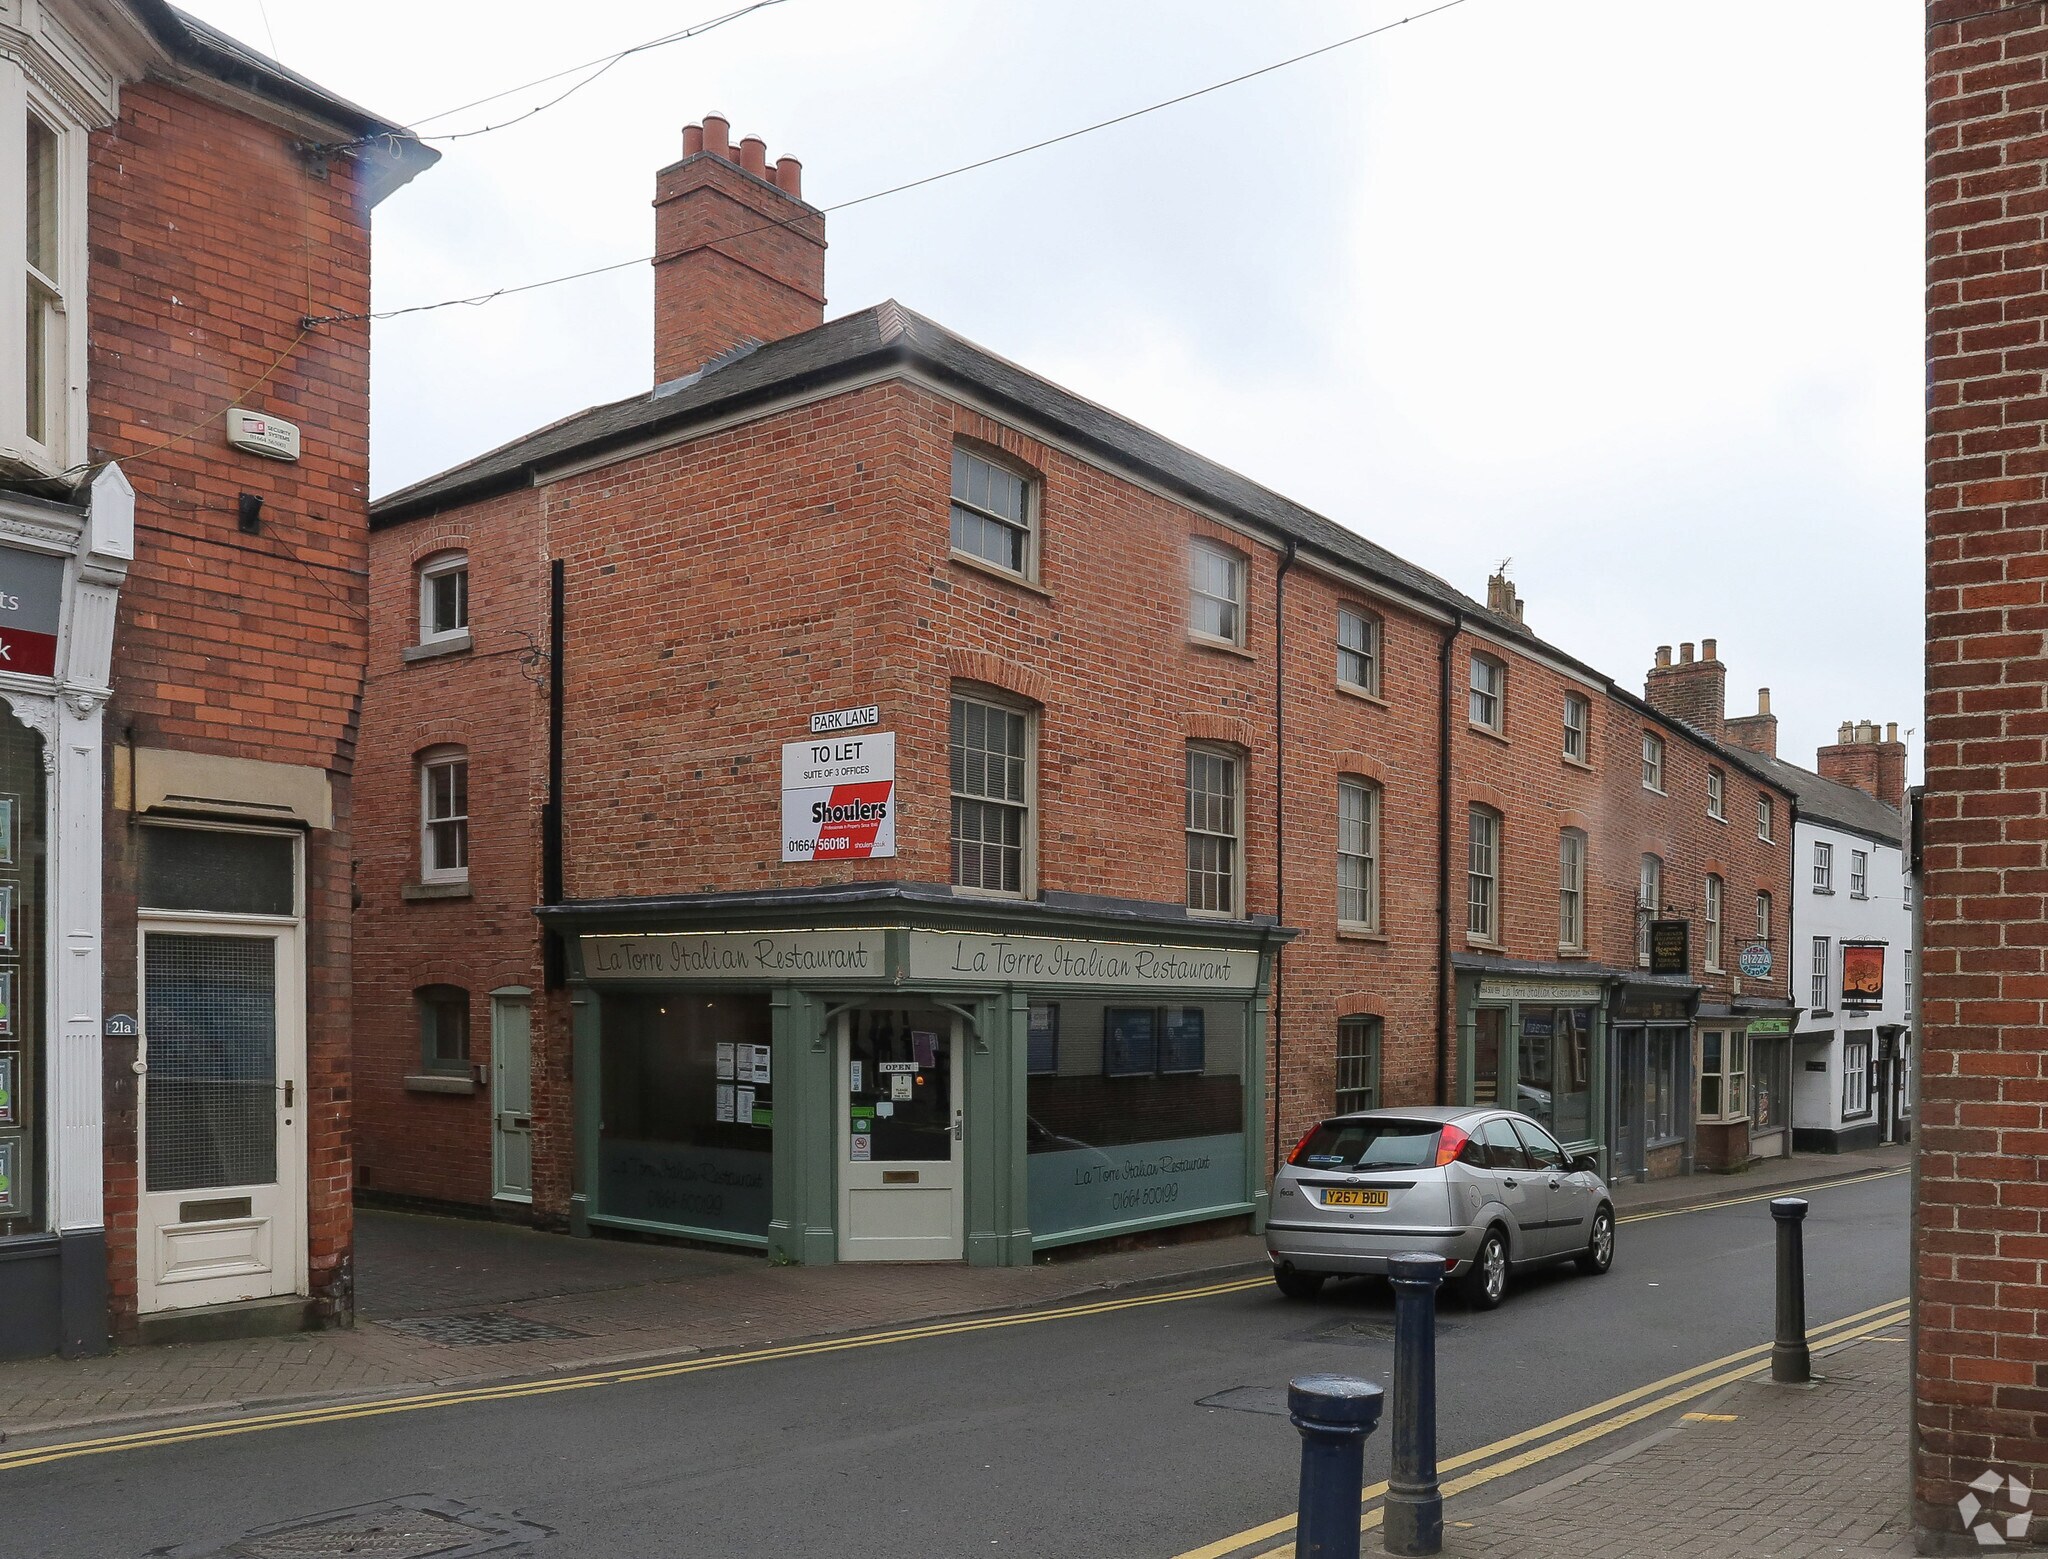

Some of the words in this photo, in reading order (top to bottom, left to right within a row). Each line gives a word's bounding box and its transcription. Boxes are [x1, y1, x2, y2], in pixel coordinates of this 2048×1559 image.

[814, 712, 842, 730] PARK
[846, 708, 875, 726] LANE
[811, 746, 830, 764] TO
[836, 742, 863, 761] LET
[804, 770, 822, 780] SUITE
[824, 768, 834, 778] OF
[836, 768, 840, 776] 3
[841, 765, 870, 776] OFFICES
[812, 798, 887, 823] Shoulers
[788, 839, 816, 852] 01664
[818, 837, 850, 850] 560181
[596, 943, 622, 972] La
[620, 943, 663, 972] Torre
[670, 941, 749, 972] Italian
[753, 938, 868, 970] Restaurant
[952, 940, 988, 972] La
[991, 942, 1044, 974] Torre
[1048, 944, 1131, 978] Italian
[1134, 950, 1232, 980] Restaurant
[1742, 954, 1770, 964] PIZZA
[112, 1021, 132, 1033] 21a
[1074, 1168, 1092, 1186] La
[1093, 1165, 1120, 1184] Torre
[1122, 1160, 1158, 1180] Italian
[1160, 1155, 1210, 1174] Restaurant
[1328, 1191, 1359, 1204] Y267
[1362, 1192, 1386, 1204] BDU
